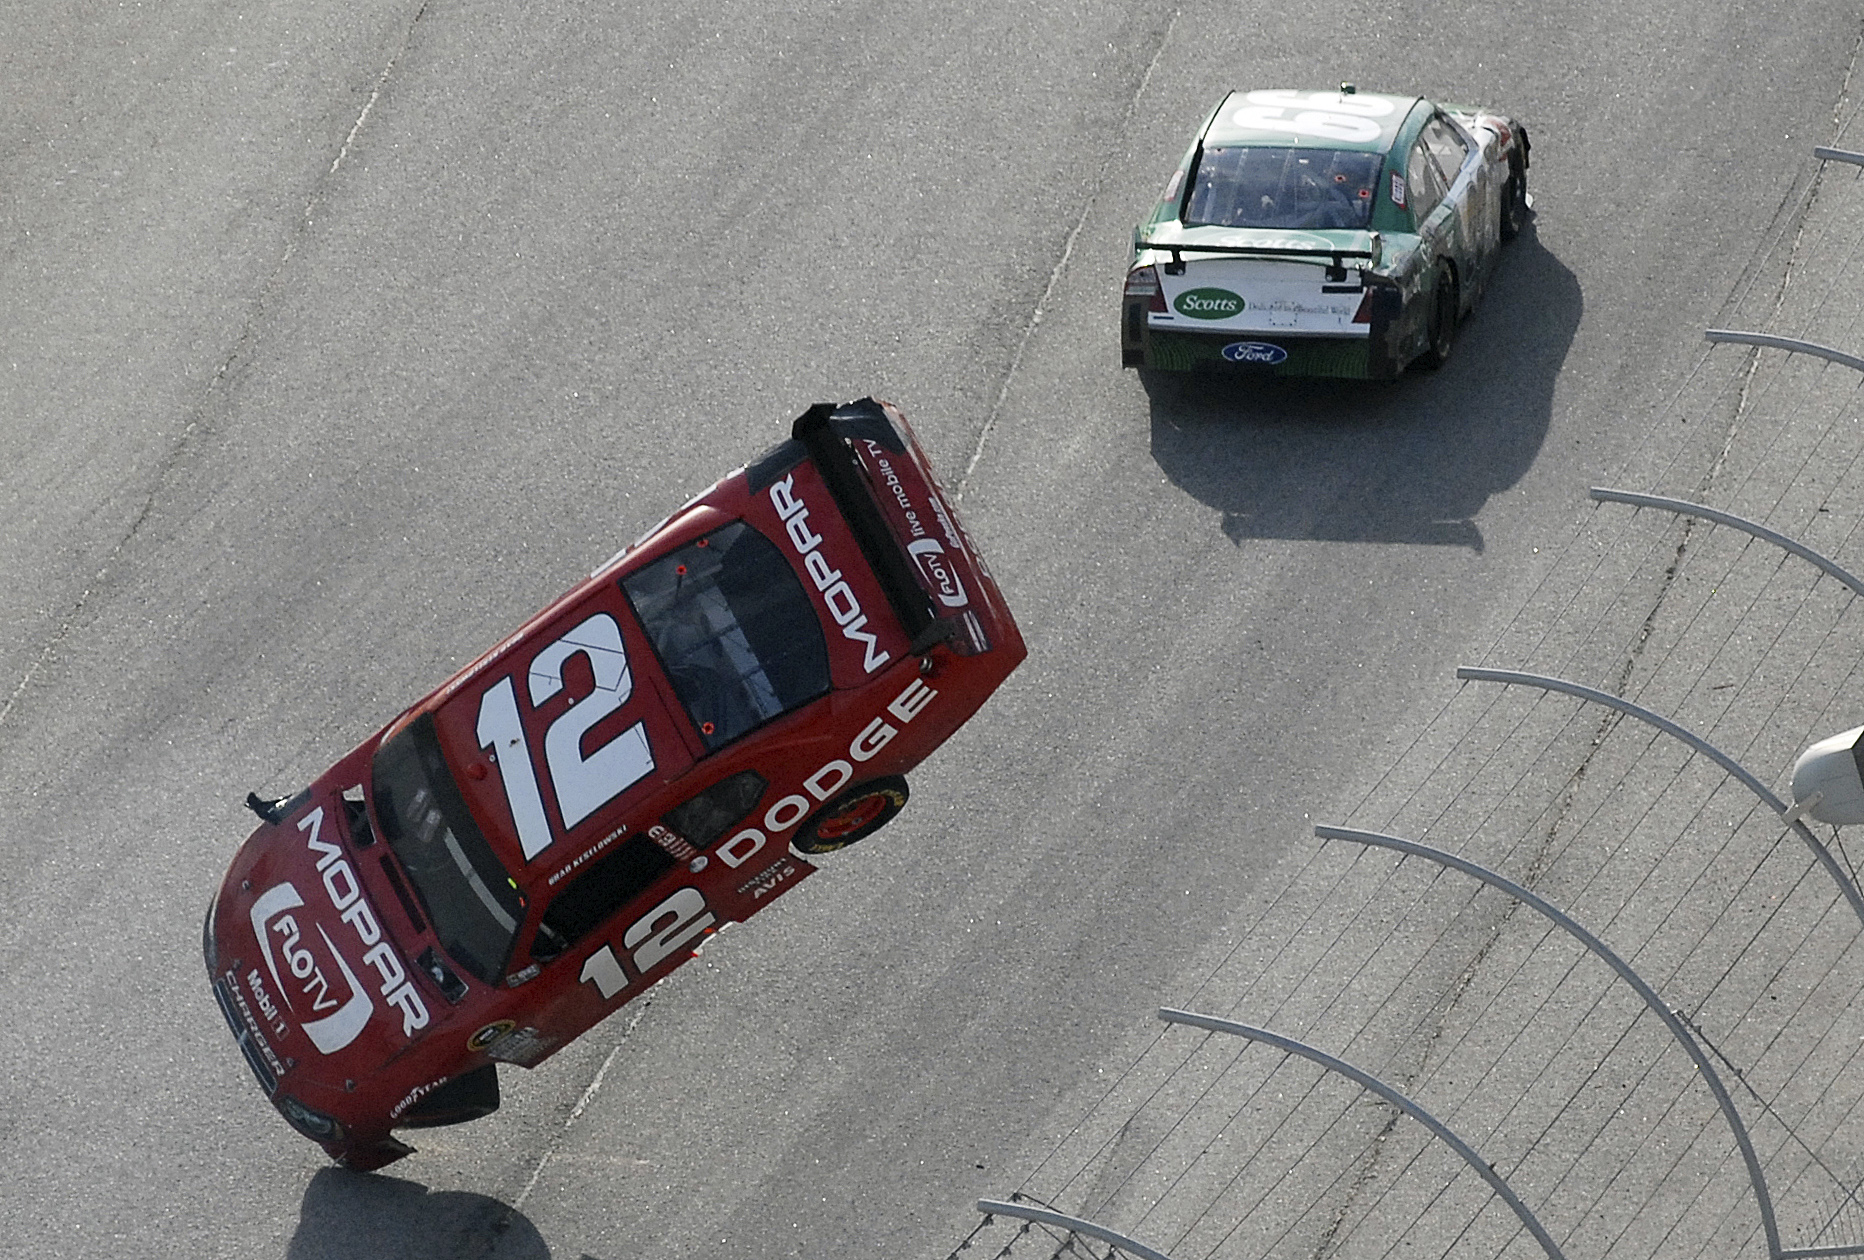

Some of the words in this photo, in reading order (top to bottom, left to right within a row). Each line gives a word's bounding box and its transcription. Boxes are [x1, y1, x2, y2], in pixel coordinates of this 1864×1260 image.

[1182, 293, 1237, 311] Scotts
[1233, 344, 1275, 362] Ford
[862, 438, 883, 458] TV
[878, 458, 911, 509] mobile
[906, 510, 926, 537] live
[769, 473, 891, 674] MOPAR
[475, 611, 656, 863] 12
[715, 677, 939, 870] DODGE
[549, 864, 573, 886] BRAD
[753, 865, 796, 899] AVIS
[296, 805, 430, 1038] MOPAR
[579, 886, 717, 1000] 12
[246, 968, 278, 1021] Mobil
[225, 969, 285, 1077] CHARGER
[389, 1076, 447, 1120] GOODYEAR
